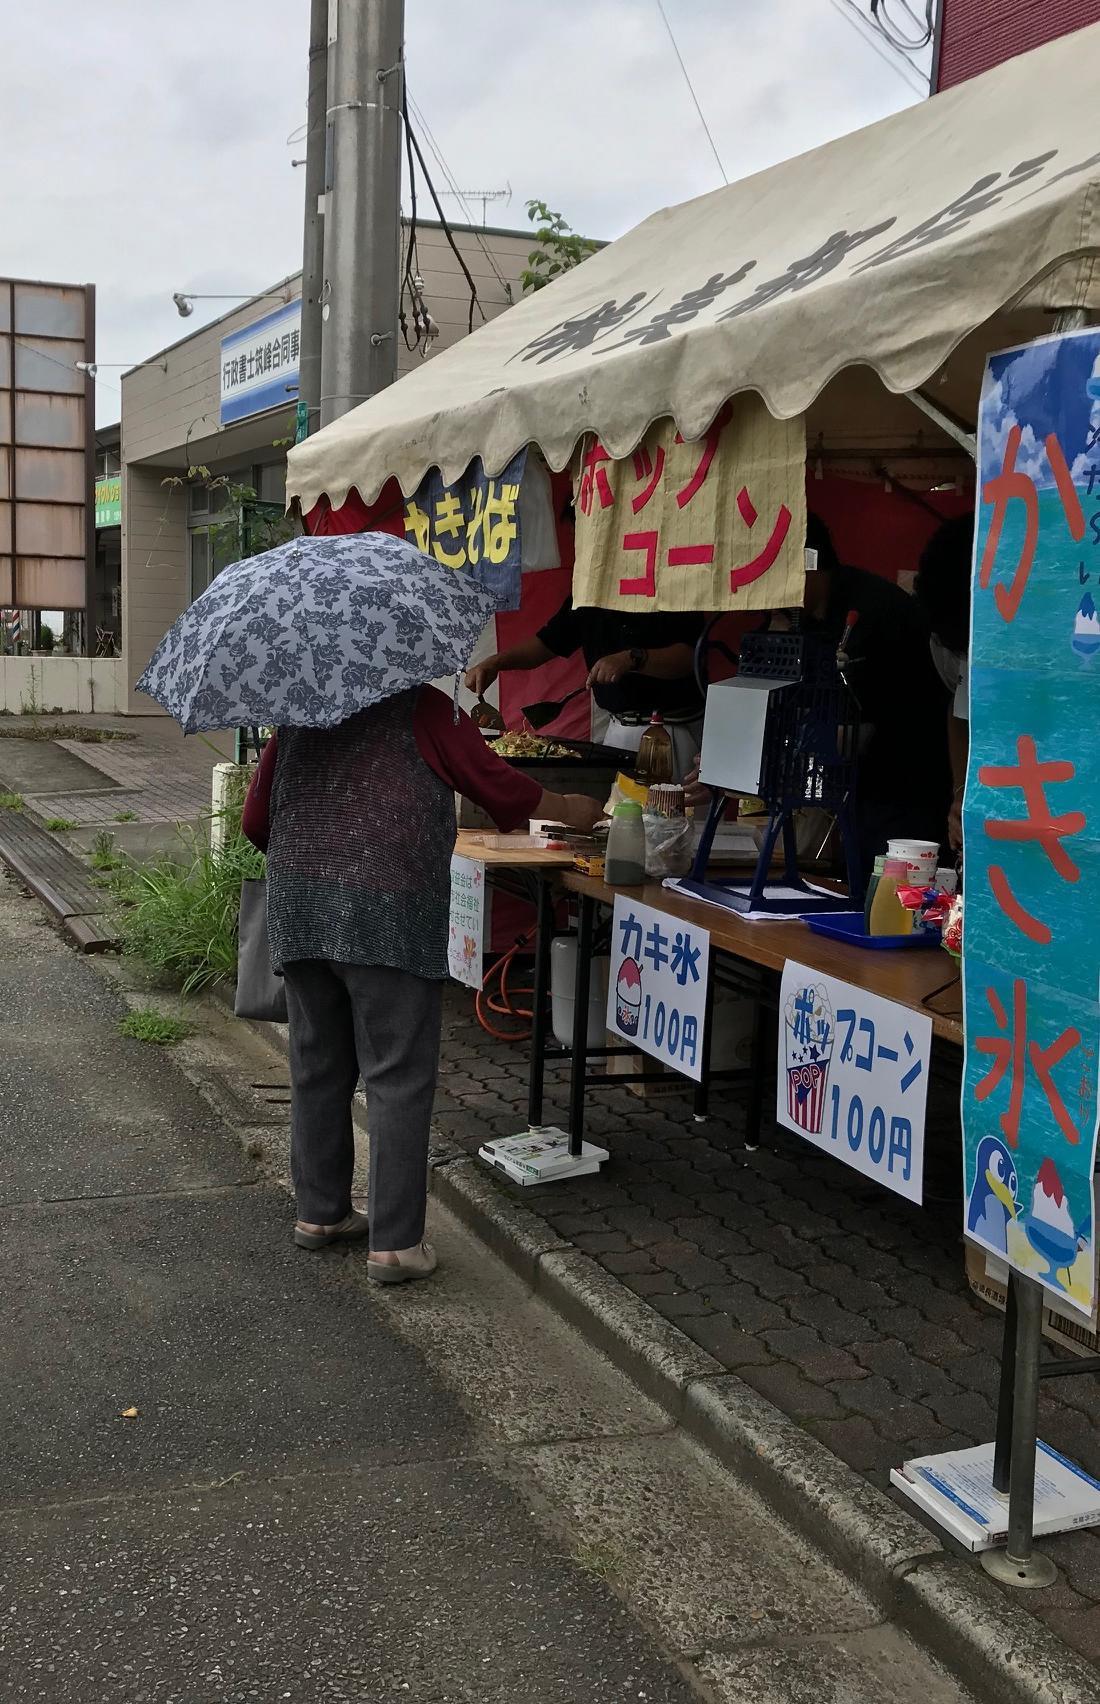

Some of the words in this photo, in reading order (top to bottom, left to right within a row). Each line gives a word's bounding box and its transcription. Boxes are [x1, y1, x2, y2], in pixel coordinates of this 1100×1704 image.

[403, 480, 520, 569] やきそば
[619, 485, 793, 598] コーン
[974, 424, 1087, 1149] かき氷
[619, 912, 702, 986] カキ氷
[642, 994, 698, 1067] 100円
[794, 988, 922, 1095] ポップコーン
[790, 1063, 821, 1095] POP
[831, 1083, 912, 1182] 100円
